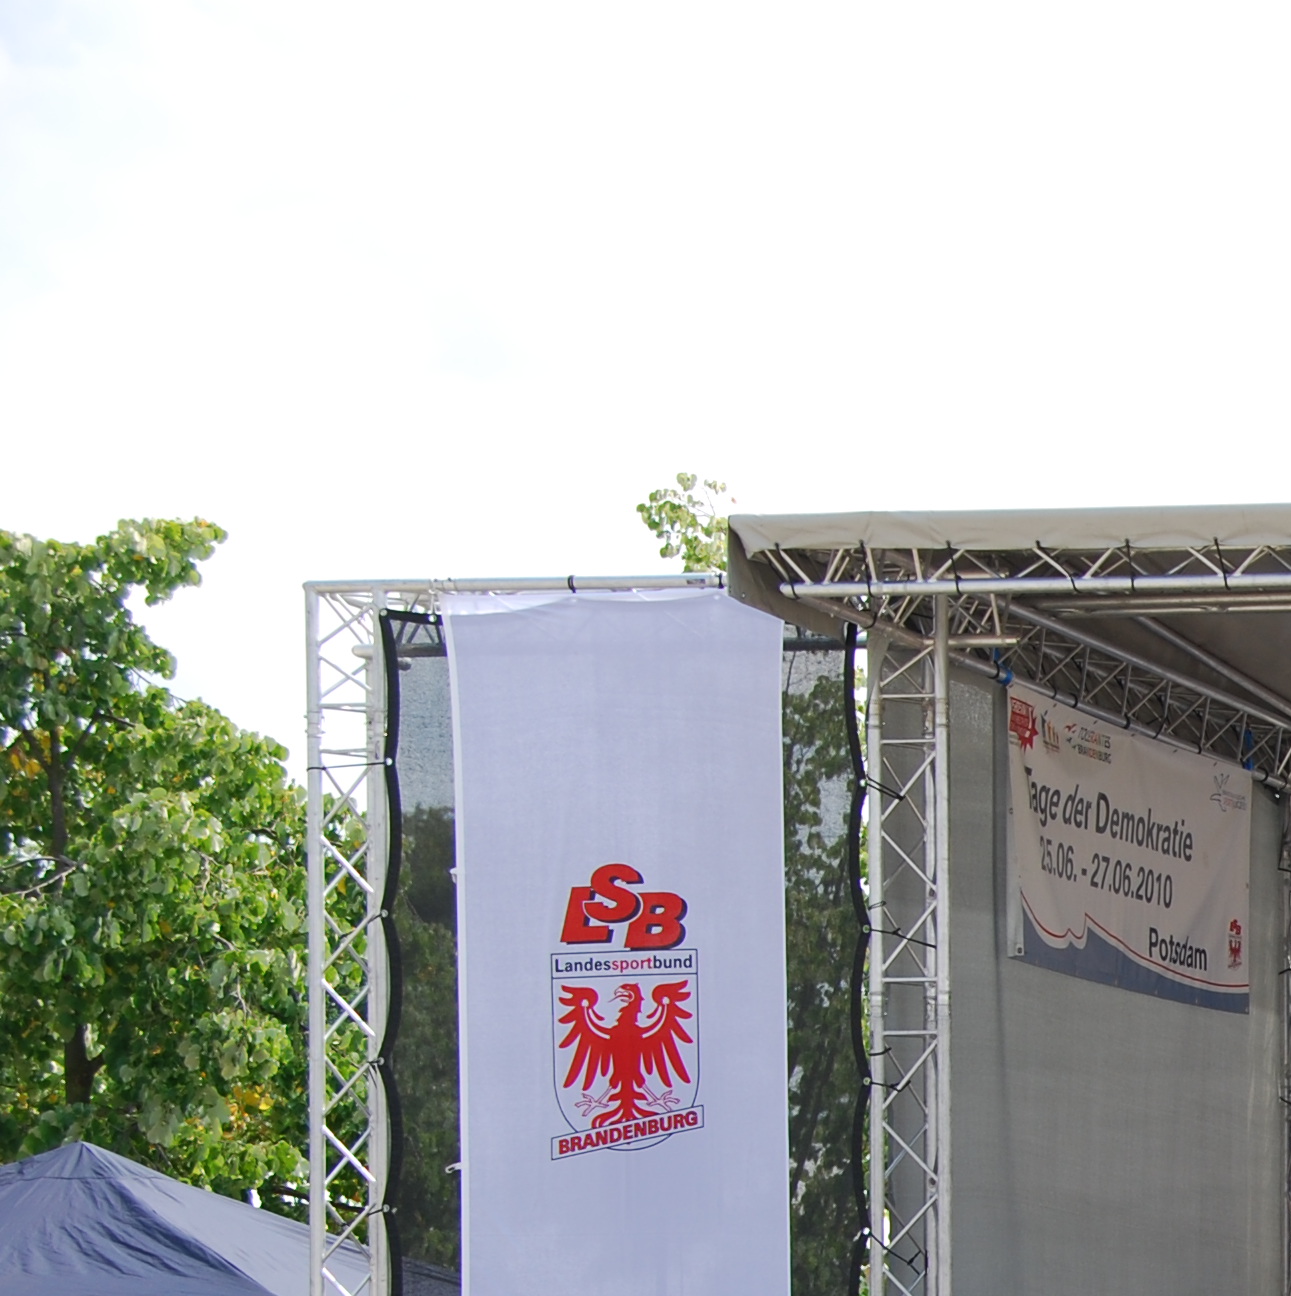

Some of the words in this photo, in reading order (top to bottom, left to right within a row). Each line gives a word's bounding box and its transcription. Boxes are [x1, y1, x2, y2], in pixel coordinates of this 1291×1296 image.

[1062, 784, 1092, 831] der
[1095, 792, 1194, 863] Demokratie
[1091, 854, 1174, 910] 27.06.2010
[554, 952, 694, 974] Landessportbund
[1148, 926, 1209, 972] Potsdam
[557, 1109, 699, 1157] BRANDENBURG
